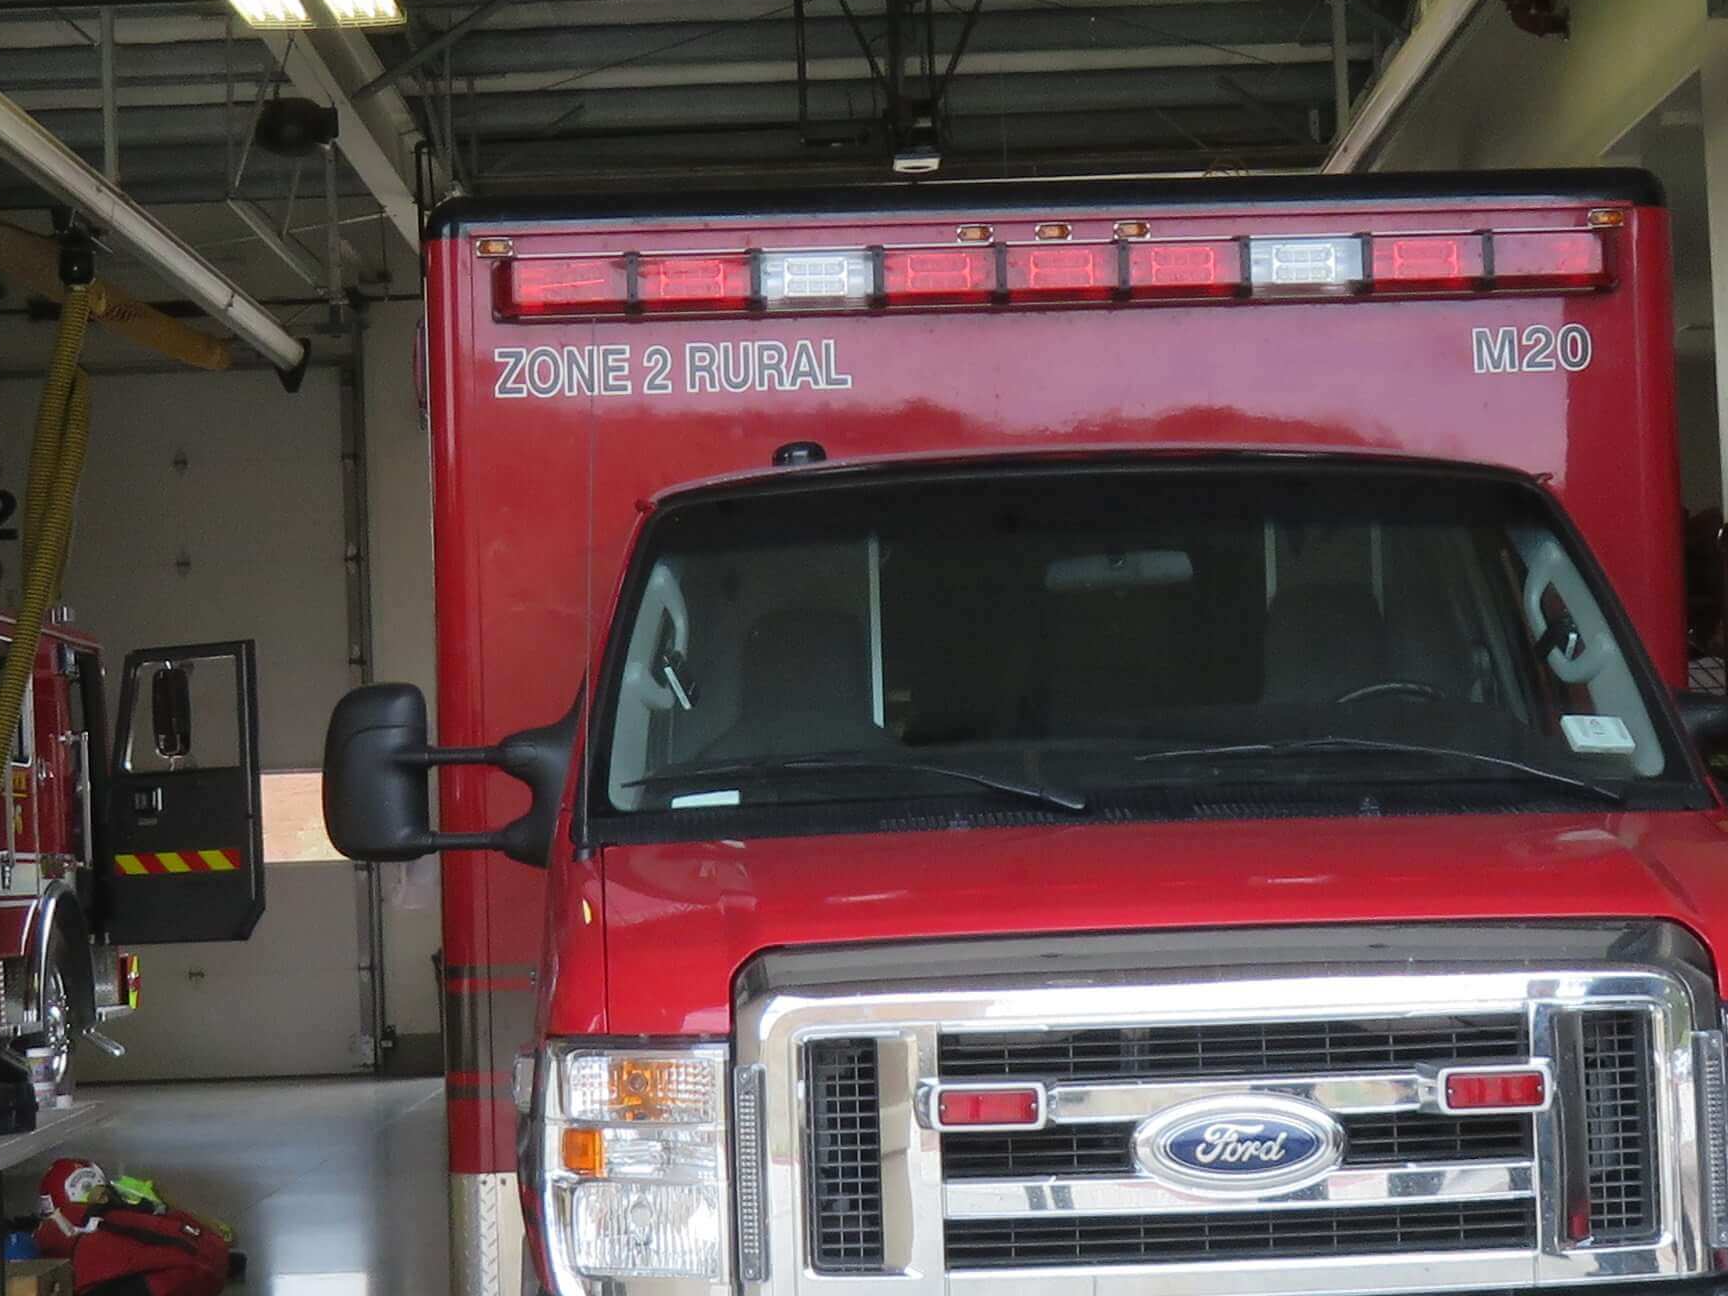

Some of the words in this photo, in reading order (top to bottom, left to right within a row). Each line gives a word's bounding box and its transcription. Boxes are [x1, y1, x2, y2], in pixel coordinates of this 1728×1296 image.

[494, 345, 632, 398] ZONE
[643, 345, 673, 394] 2
[686, 339, 853, 393] RURAL
[1473, 323, 1592, 373] M20
[1196, 1123, 1289, 1164] Ford
